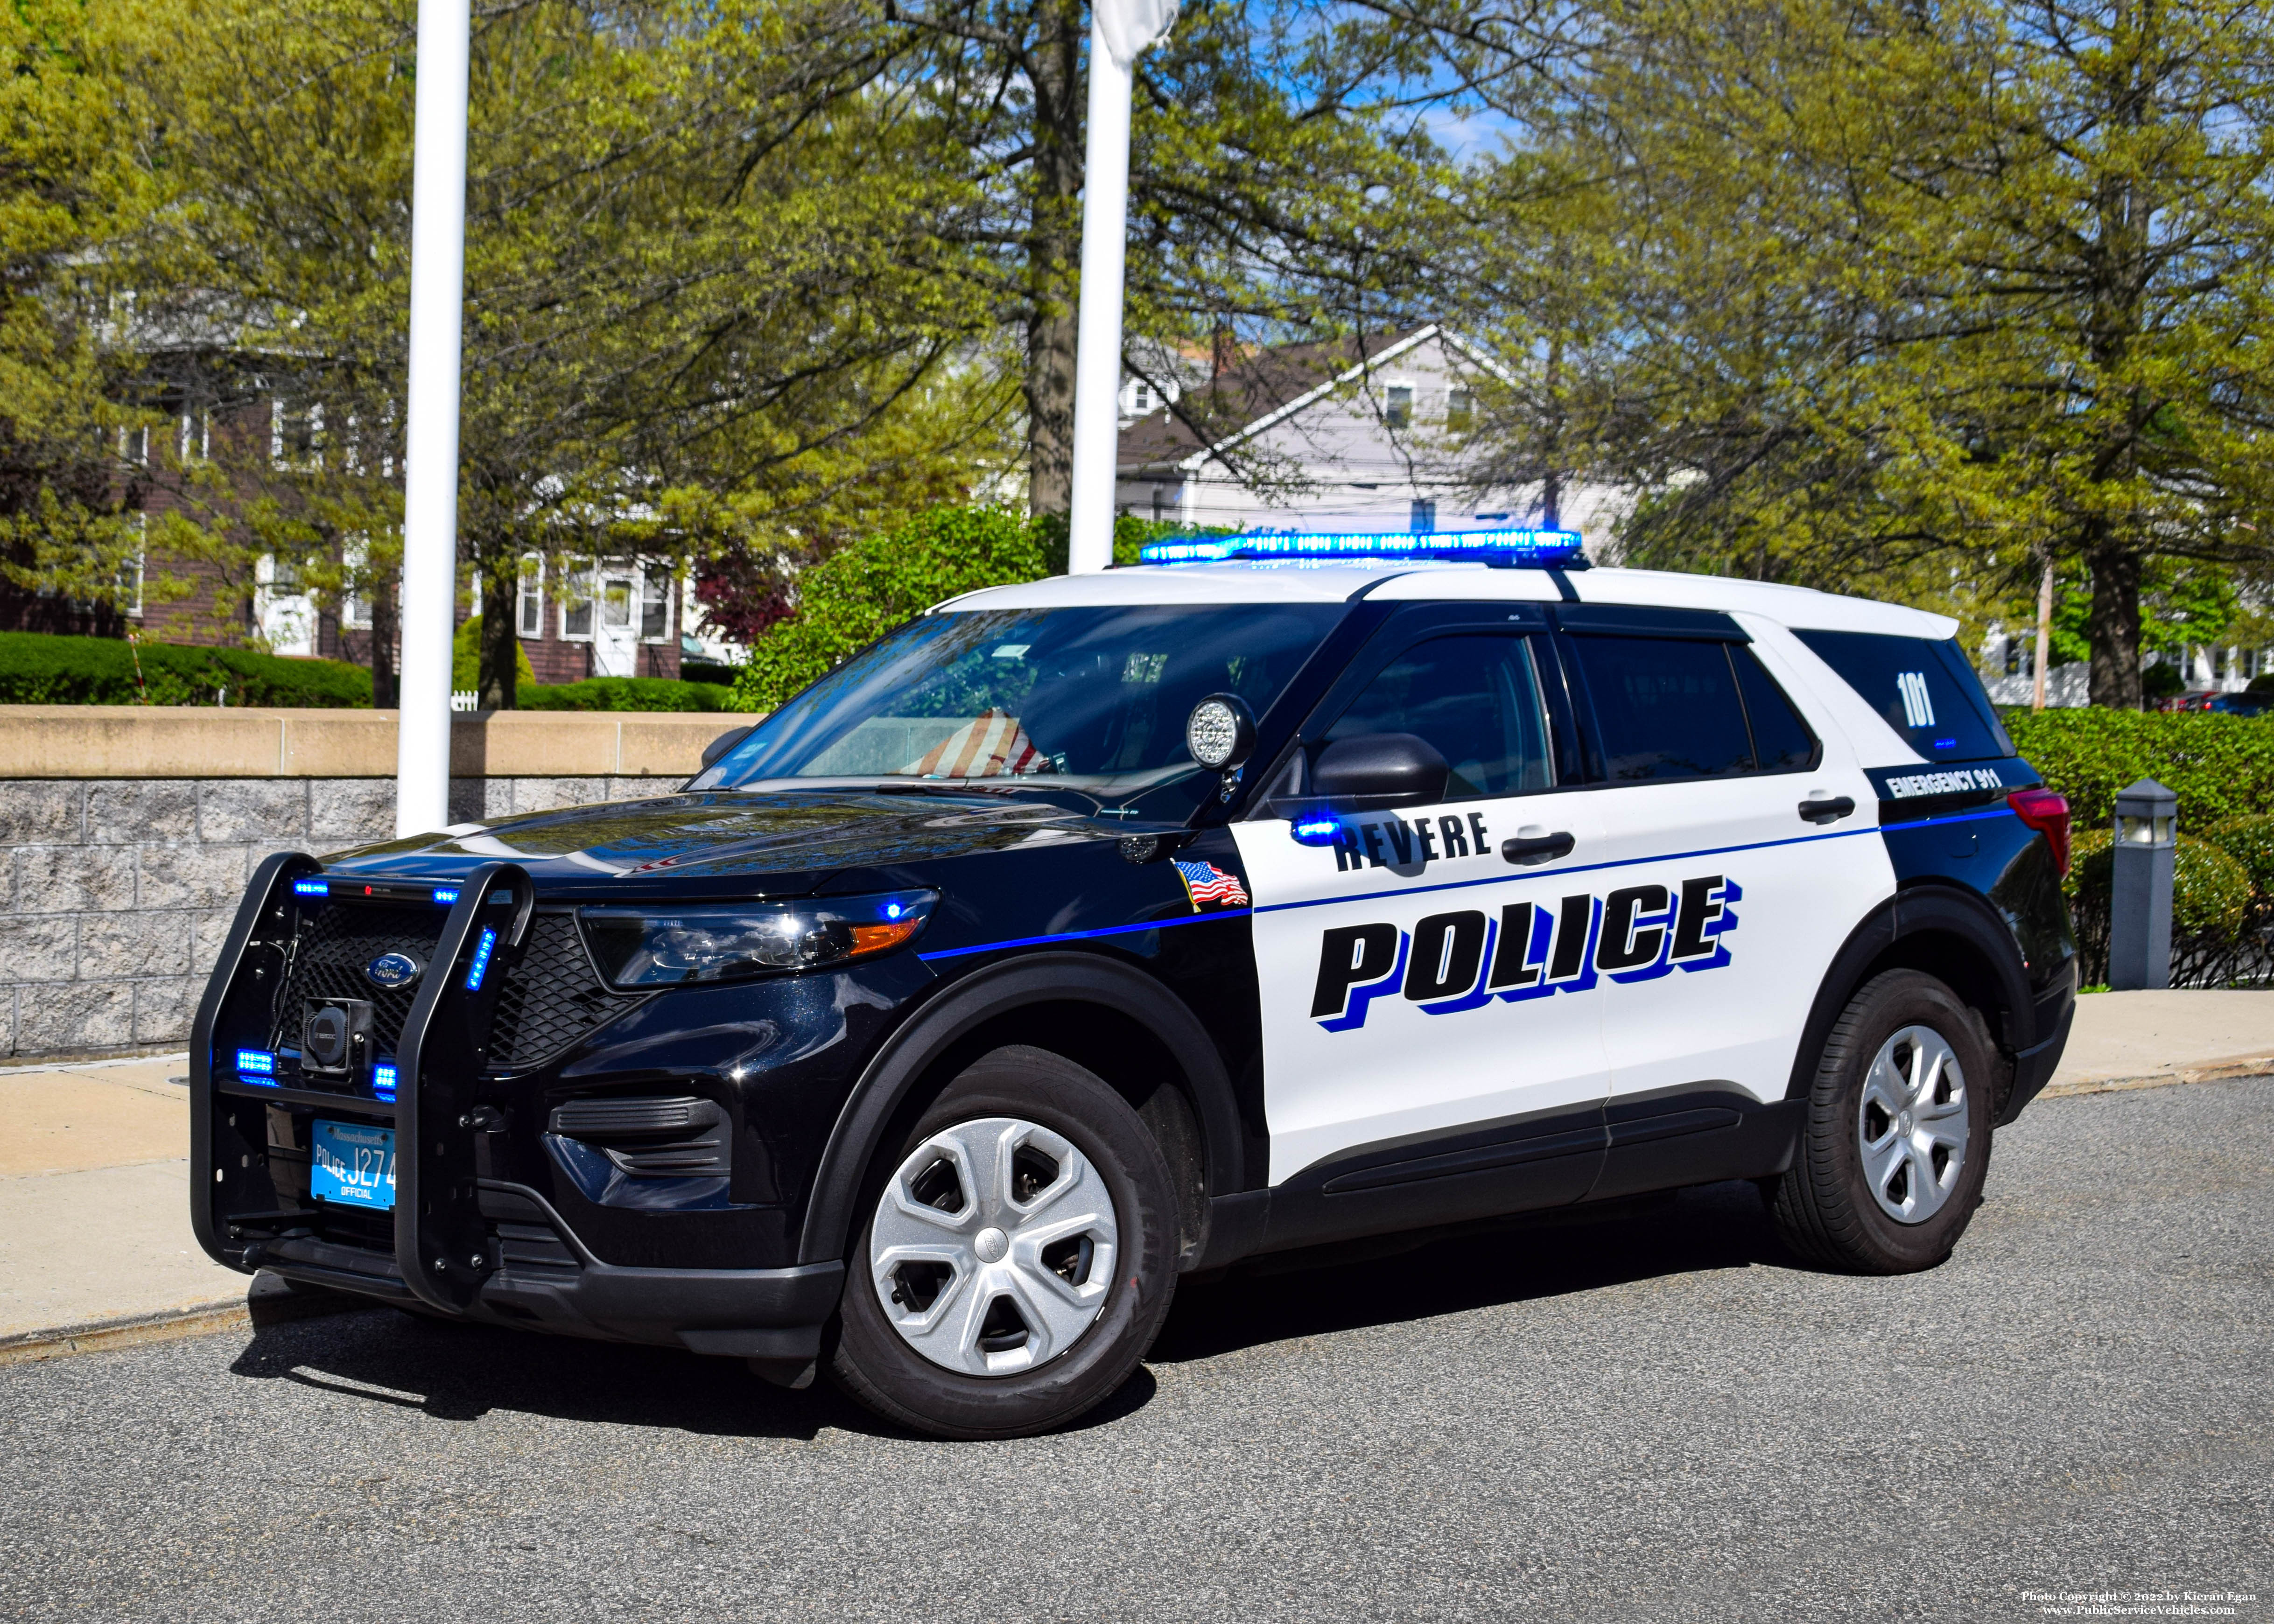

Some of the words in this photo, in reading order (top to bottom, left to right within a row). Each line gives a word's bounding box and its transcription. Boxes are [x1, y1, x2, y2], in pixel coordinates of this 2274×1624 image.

[1897, 672, 1936, 727] 101
[1885, 770, 1977, 798] EMERGENCY
[1973, 768, 2002, 789] 911
[1333, 812, 1491, 872] REVERE
[375, 959, 403, 979] Ford
[1310, 875, 1743, 1033] POLICE
[333, 1127, 383, 1146] Massachusetts
[316, 1143, 346, 1178] POLICE
[341, 1186, 372, 1200] OFFICIAL
